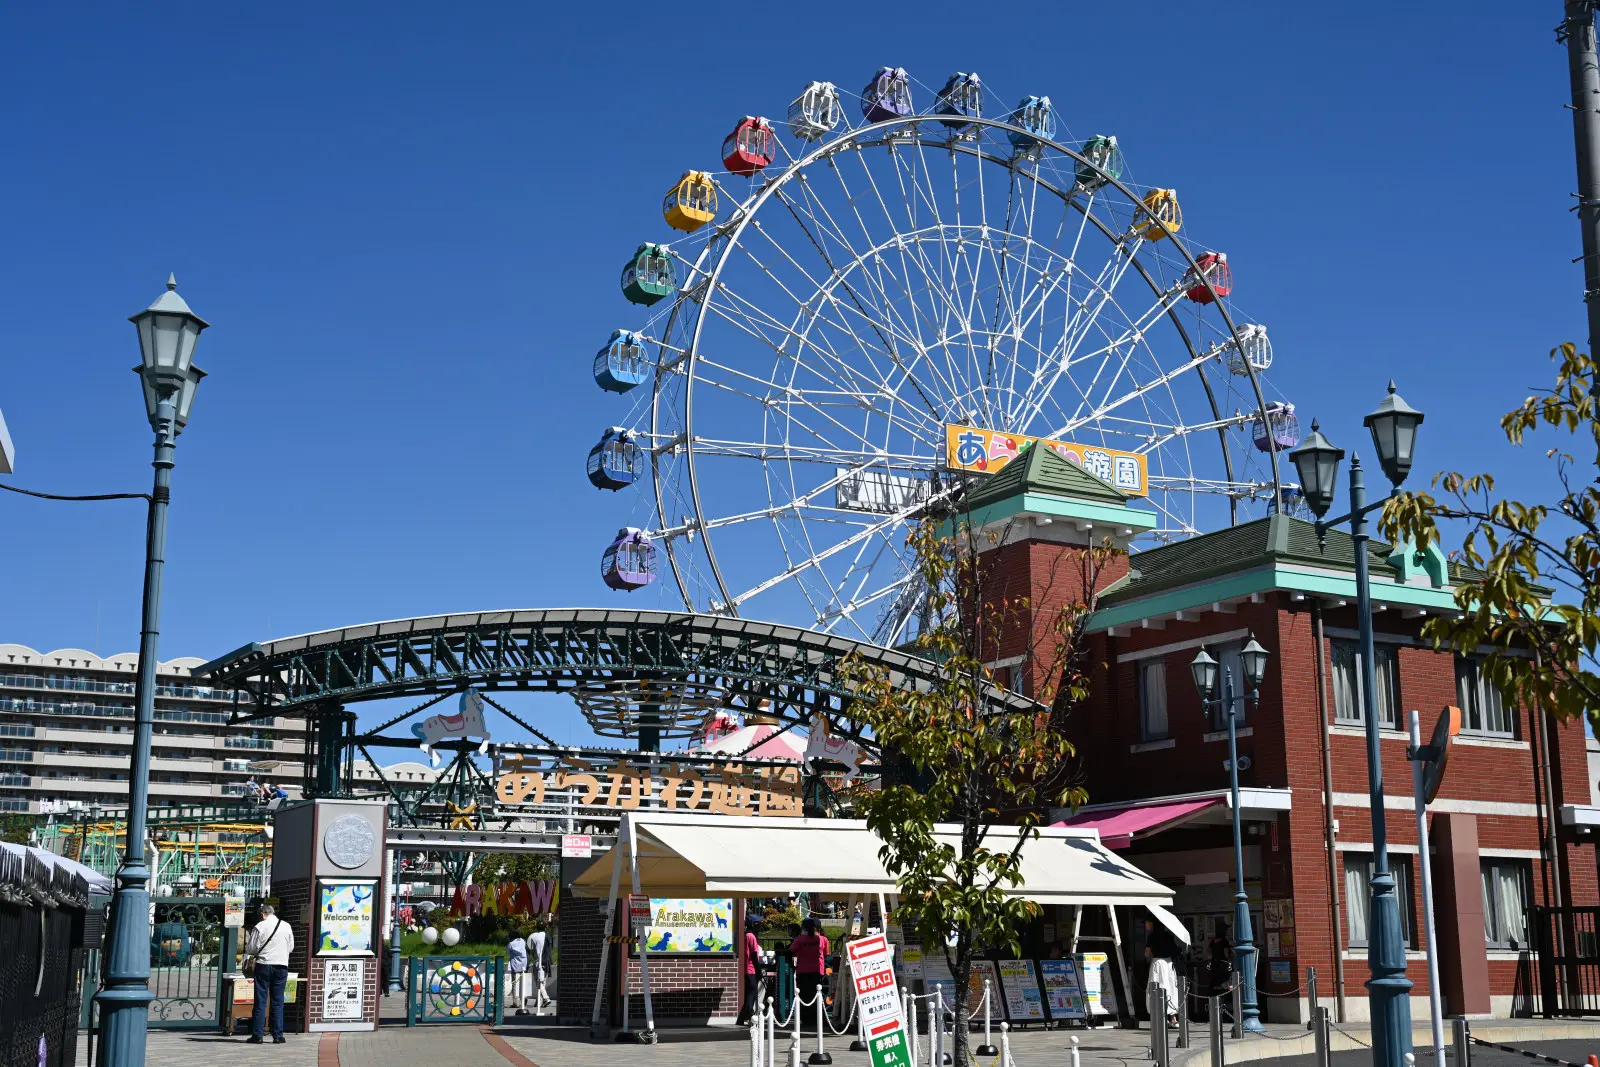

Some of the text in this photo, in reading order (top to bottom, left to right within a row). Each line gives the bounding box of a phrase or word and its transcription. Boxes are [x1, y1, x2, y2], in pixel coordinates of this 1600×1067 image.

[957, 429, 1142, 491] あら遊園
[496, 752, 803, 817] あらかわ遊園
[323, 913, 359, 921] Welcome
[656, 908, 714, 923] Arakawa
[655, 920, 715, 928] Amusement Park
[331, 963, 358, 972] 再入園
[859, 973, 891, 990] 専用入口
[861, 996, 871, 1005] WEB
[875, 1033, 900, 1052] 券売機
